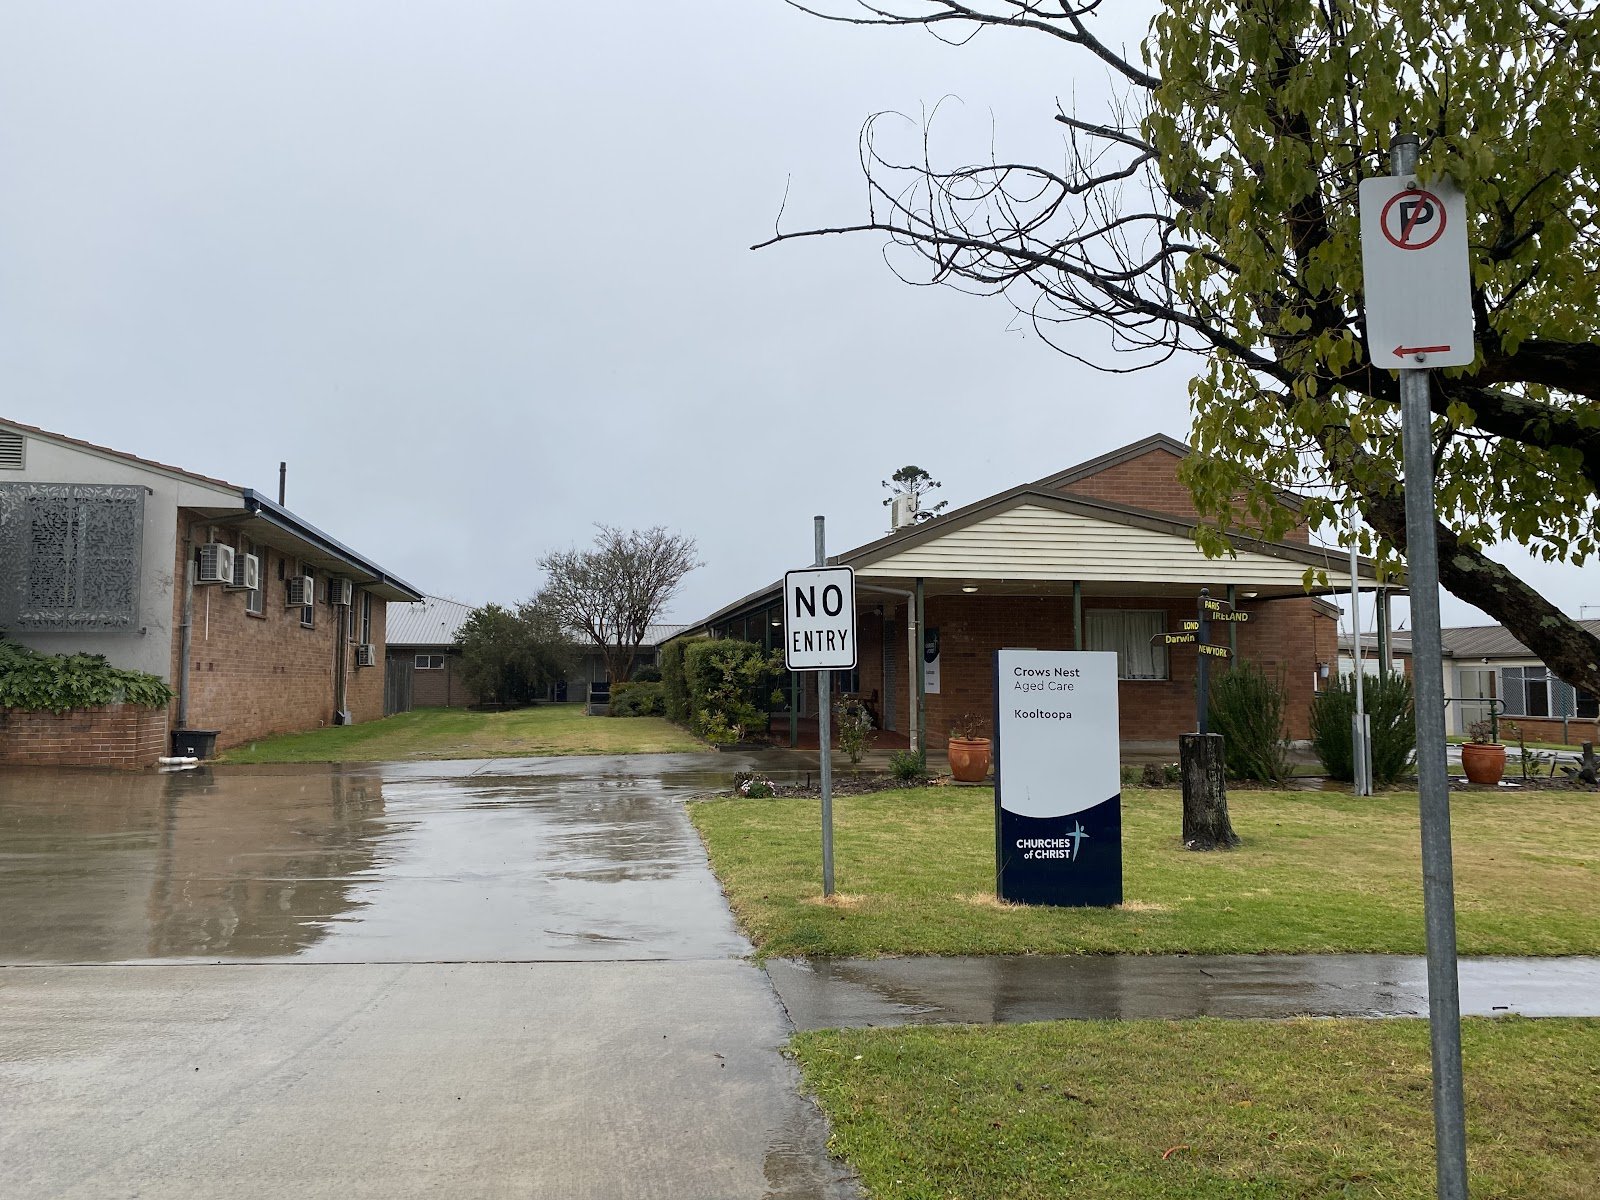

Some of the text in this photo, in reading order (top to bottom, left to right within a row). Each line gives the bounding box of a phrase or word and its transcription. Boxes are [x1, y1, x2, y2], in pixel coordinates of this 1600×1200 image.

[795, 584, 843, 618] NO
[1204, 600, 1219, 610] PARIS
[1212, 611, 1248, 621] IRELAND
[1183, 621, 1199, 630] LOND
[793, 629, 848, 653] ENTRY
[1165, 633, 1195, 643] Darwin
[1013, 666, 1081, 678] Crows Nest
[1014, 680, 1075, 693] Aged Care
[1014, 708, 1072, 721] Kooltoopa
[1016, 838, 1071, 849] CHURCHES
[1023, 849, 1071, 860] of CHRIST
